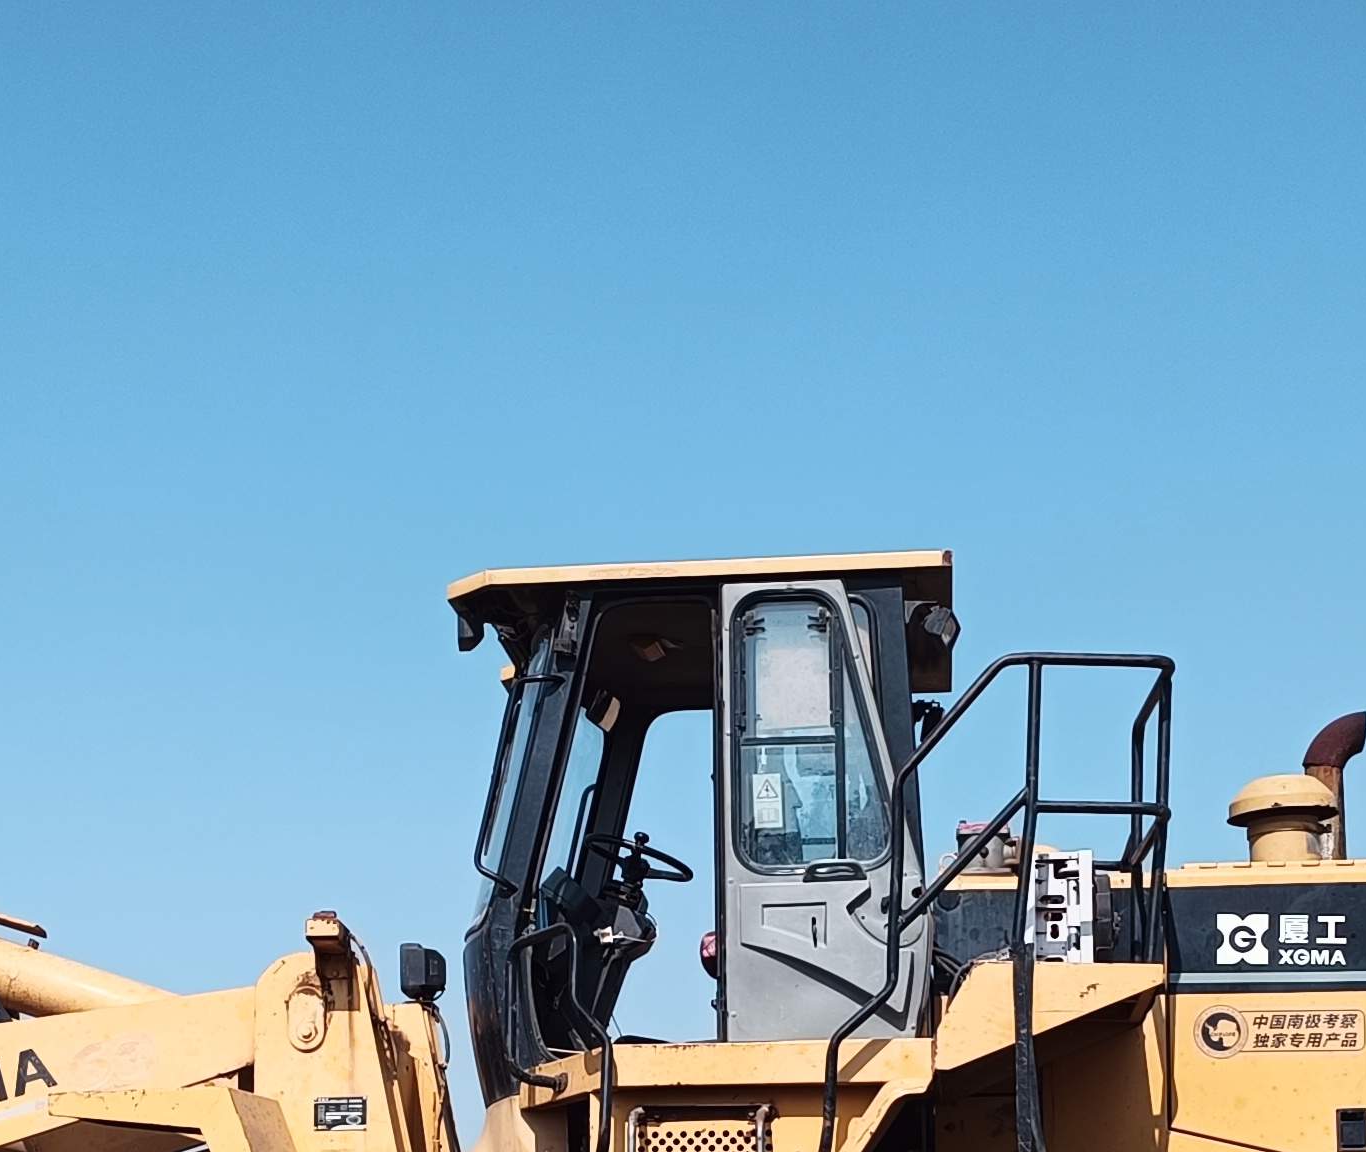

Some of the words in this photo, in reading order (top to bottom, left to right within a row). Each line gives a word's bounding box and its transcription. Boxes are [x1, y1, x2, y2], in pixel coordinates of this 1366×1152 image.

[1278, 914, 1348, 945] 厦工
[1278, 949, 1347, 966] XGMA
[1252, 1013, 1358, 1031] 中国南极考察
[1252, 1032, 1358, 1049] 独家专用产品
